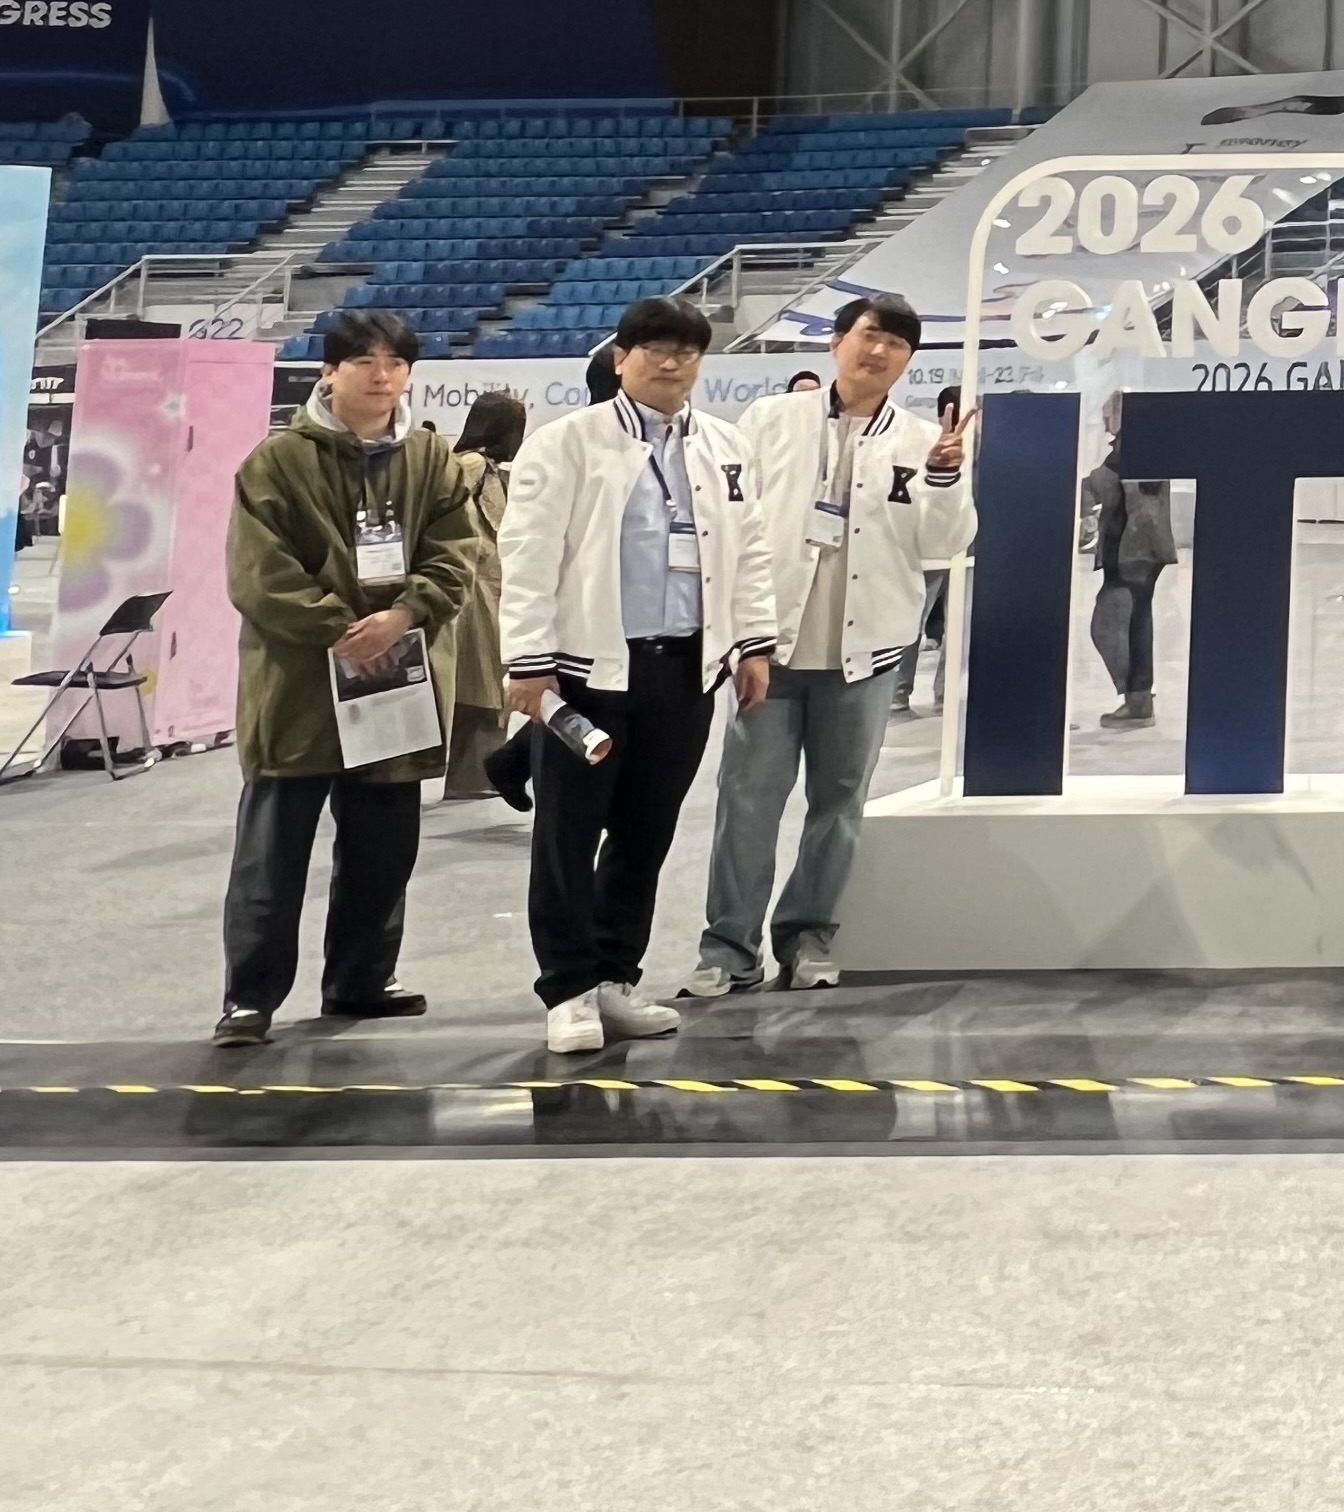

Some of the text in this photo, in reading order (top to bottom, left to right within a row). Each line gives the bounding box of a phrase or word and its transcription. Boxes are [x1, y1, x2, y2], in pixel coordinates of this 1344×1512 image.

[1014, 173, 1267, 256] 2026
[1191, 362, 1273, 391] 2026
[887, 465, 917, 504] K
